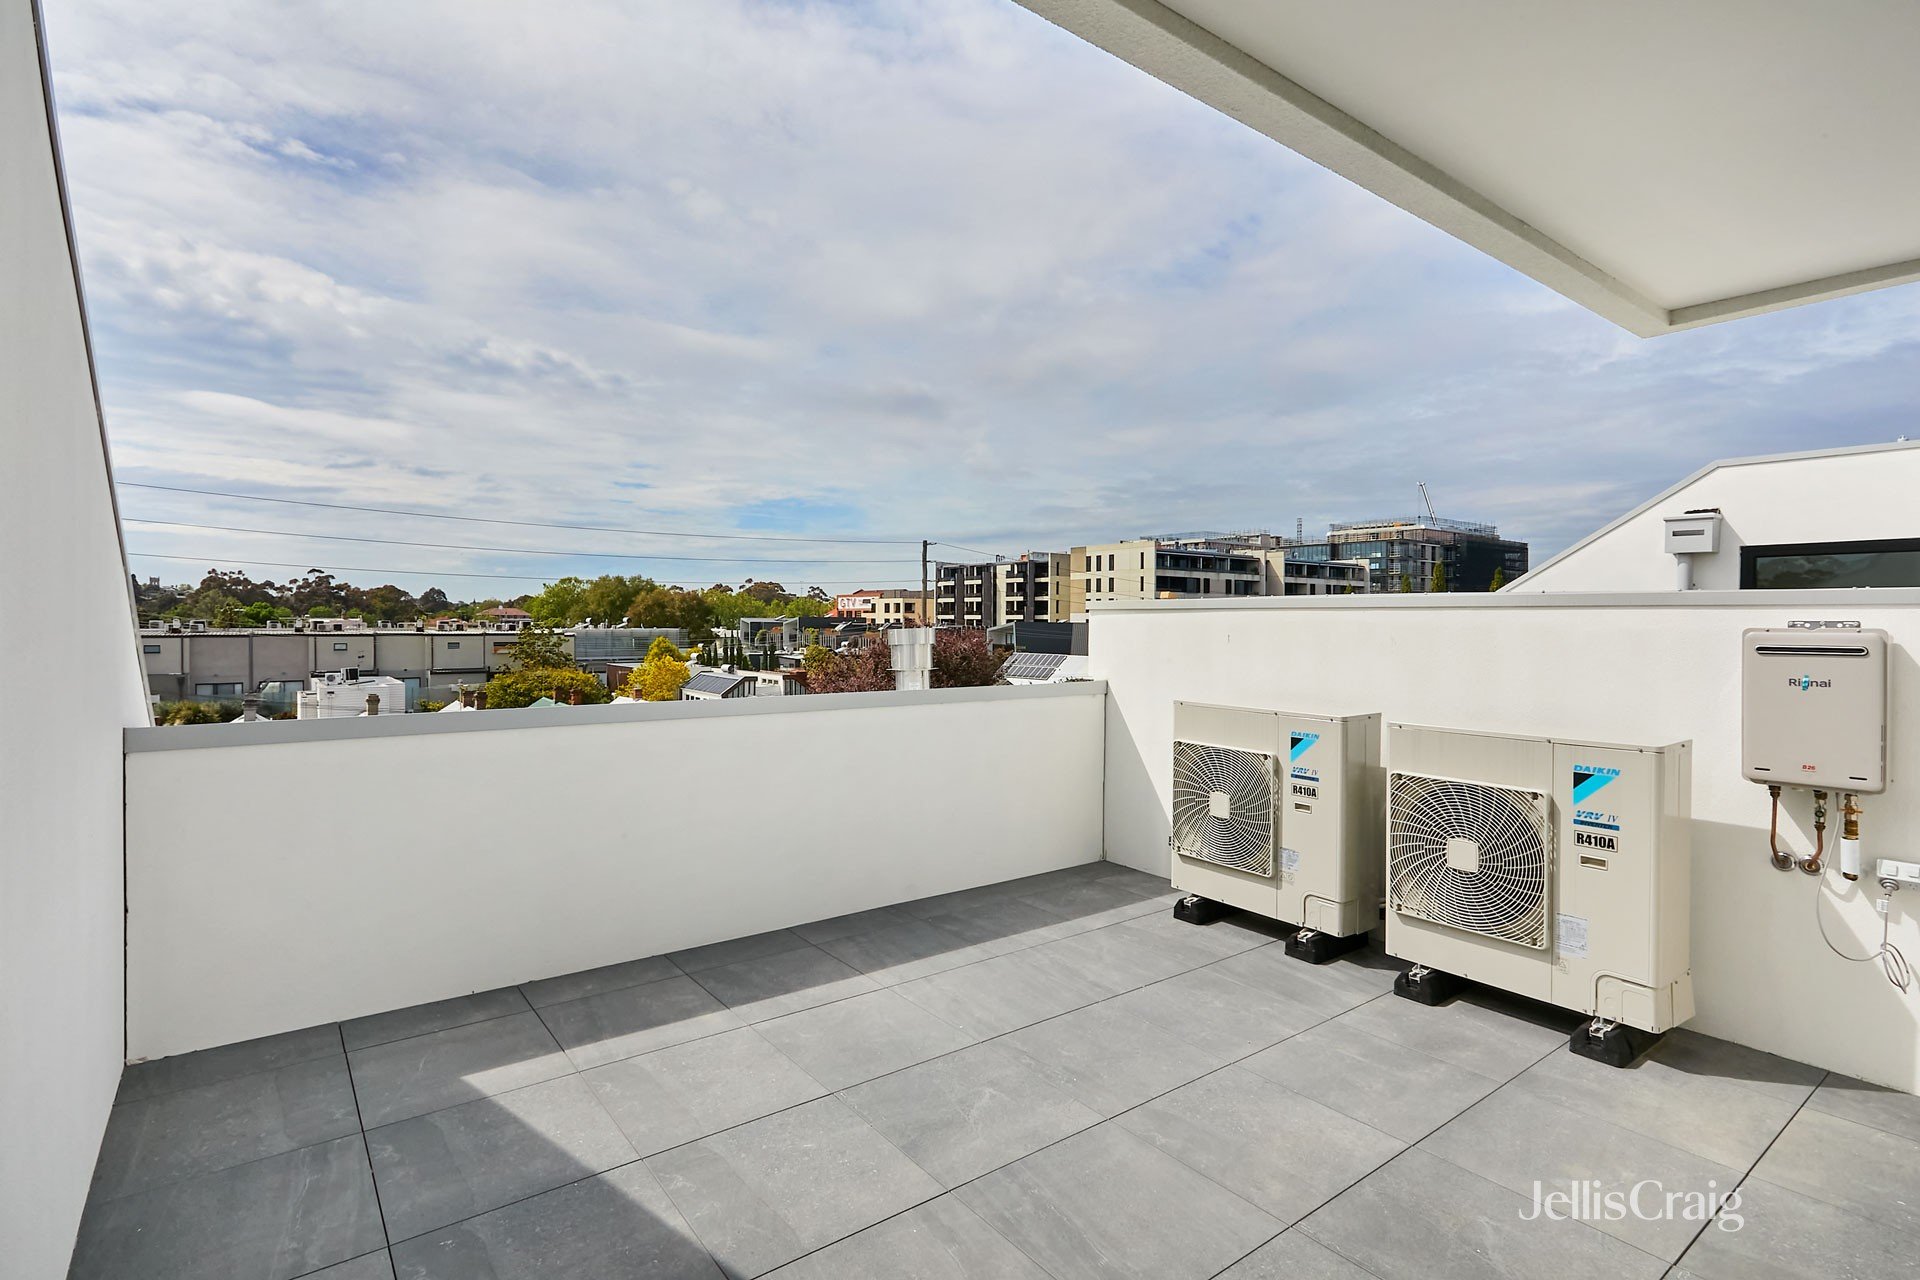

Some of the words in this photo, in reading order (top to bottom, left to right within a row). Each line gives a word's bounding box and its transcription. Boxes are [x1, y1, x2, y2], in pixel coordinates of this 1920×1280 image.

[1290, 731, 1320, 740] DAIKIN
[1292, 766, 1310, 775] VRV
[1573, 764, 1621, 776] DAIKIN
[1292, 784, 1317, 798] R410A
[1576, 809, 1604, 821] VRV
[1607, 814, 1619, 823] IV
[1576, 832, 1616, 850] R410A
